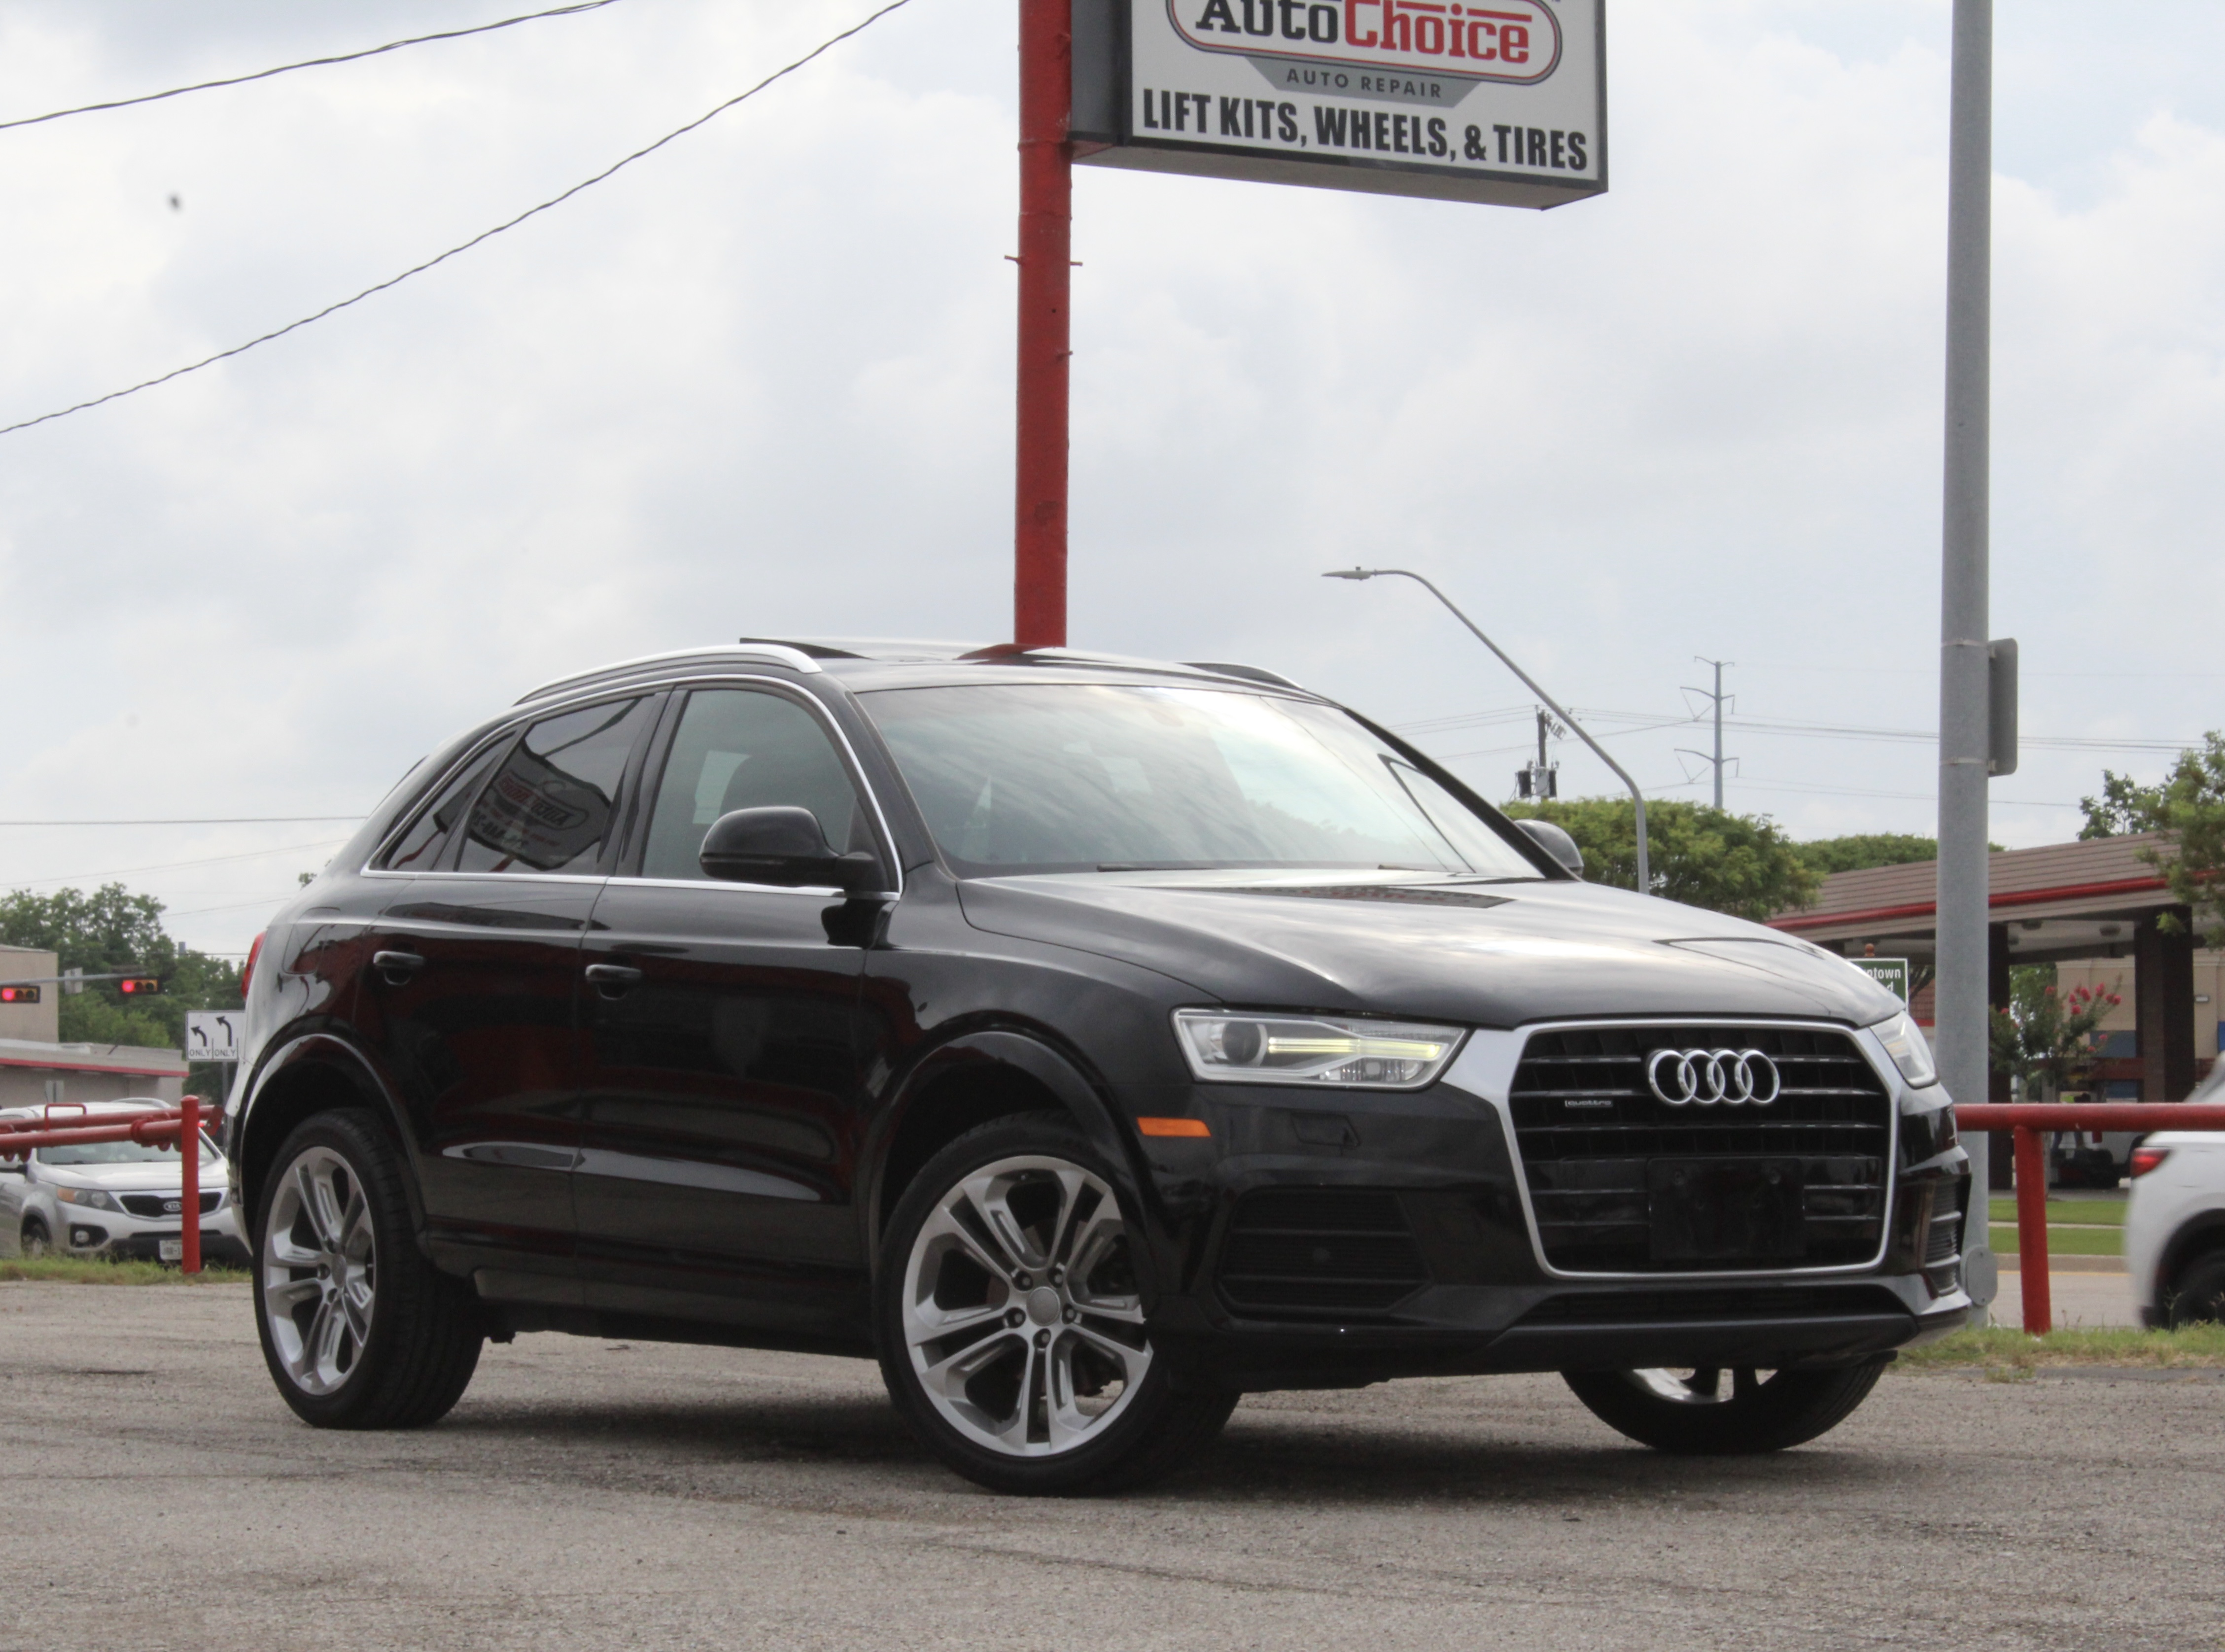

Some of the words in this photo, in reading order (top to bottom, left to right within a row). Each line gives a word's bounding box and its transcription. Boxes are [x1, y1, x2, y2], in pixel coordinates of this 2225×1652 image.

[1286, 68, 1349, 89] AUTO
[1361, 77, 1441, 99] REPAIR
[1144, 89, 1211, 134] LIFT
[1219, 96, 1308, 147] KITS,
[1313, 106, 1457, 163] WHEELS,
[1463, 124, 1487, 161] &
[1493, 124, 1588, 171] TIRES
